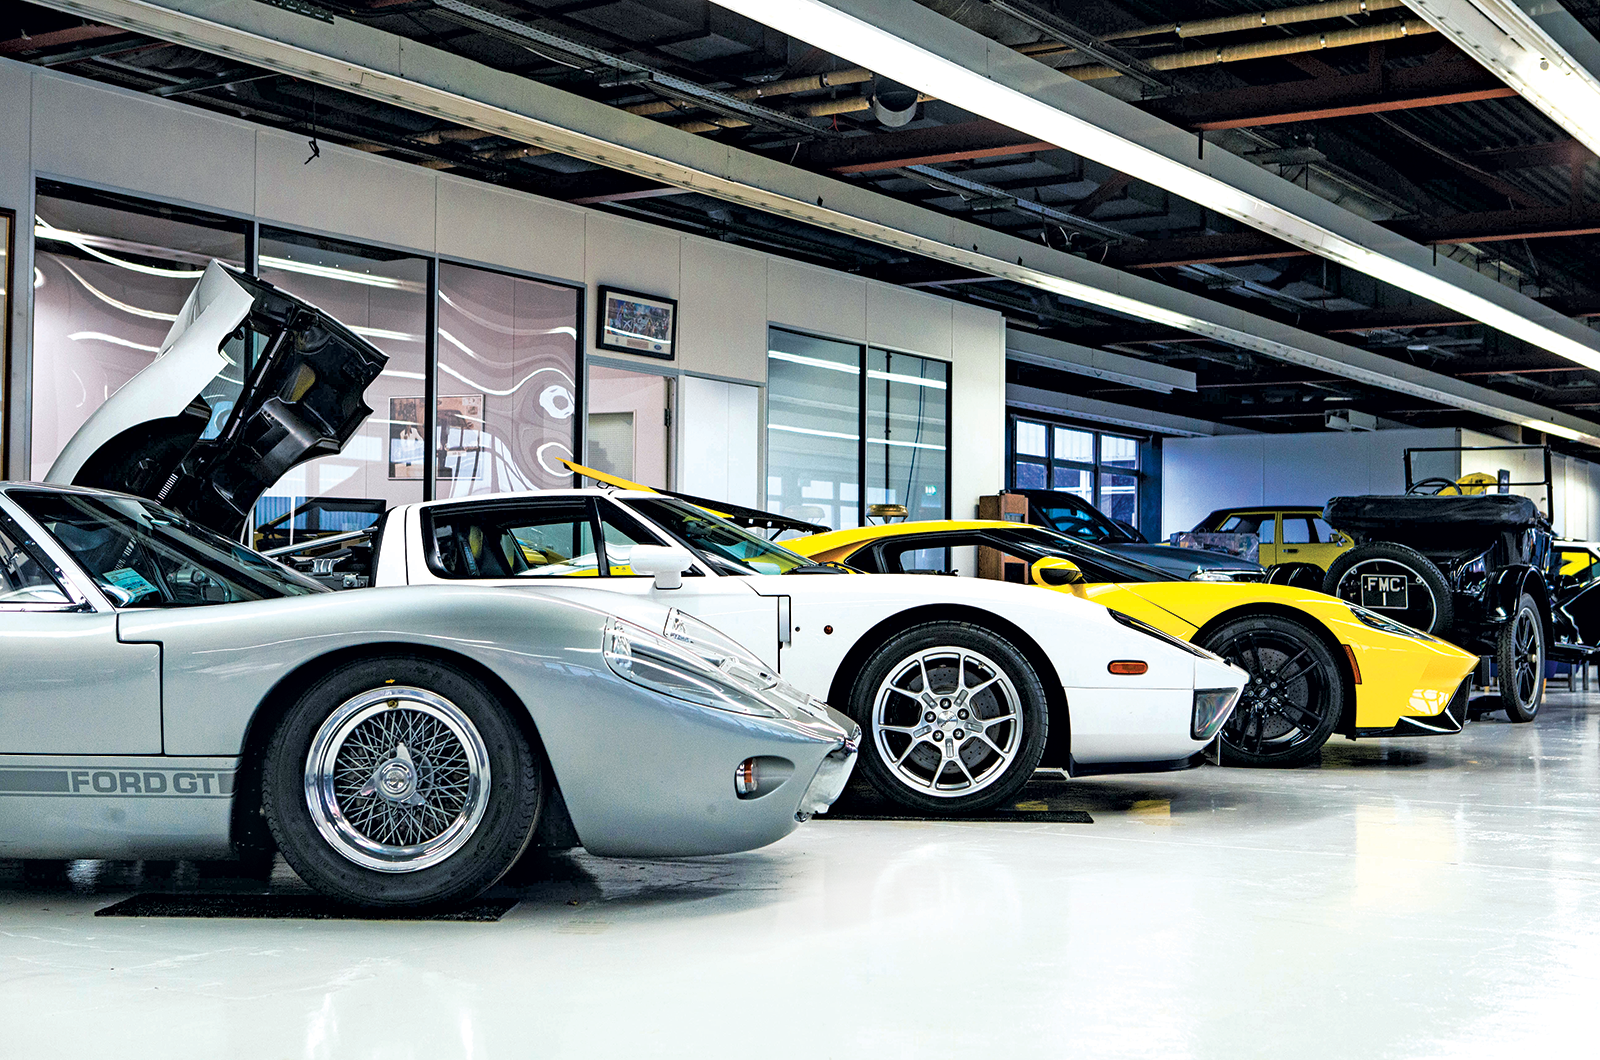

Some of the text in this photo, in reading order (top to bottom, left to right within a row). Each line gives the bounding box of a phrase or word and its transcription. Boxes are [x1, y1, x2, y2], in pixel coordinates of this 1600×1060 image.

[1367, 577, 1401, 592] FMC
[71, 771, 215, 794] FORD GT
